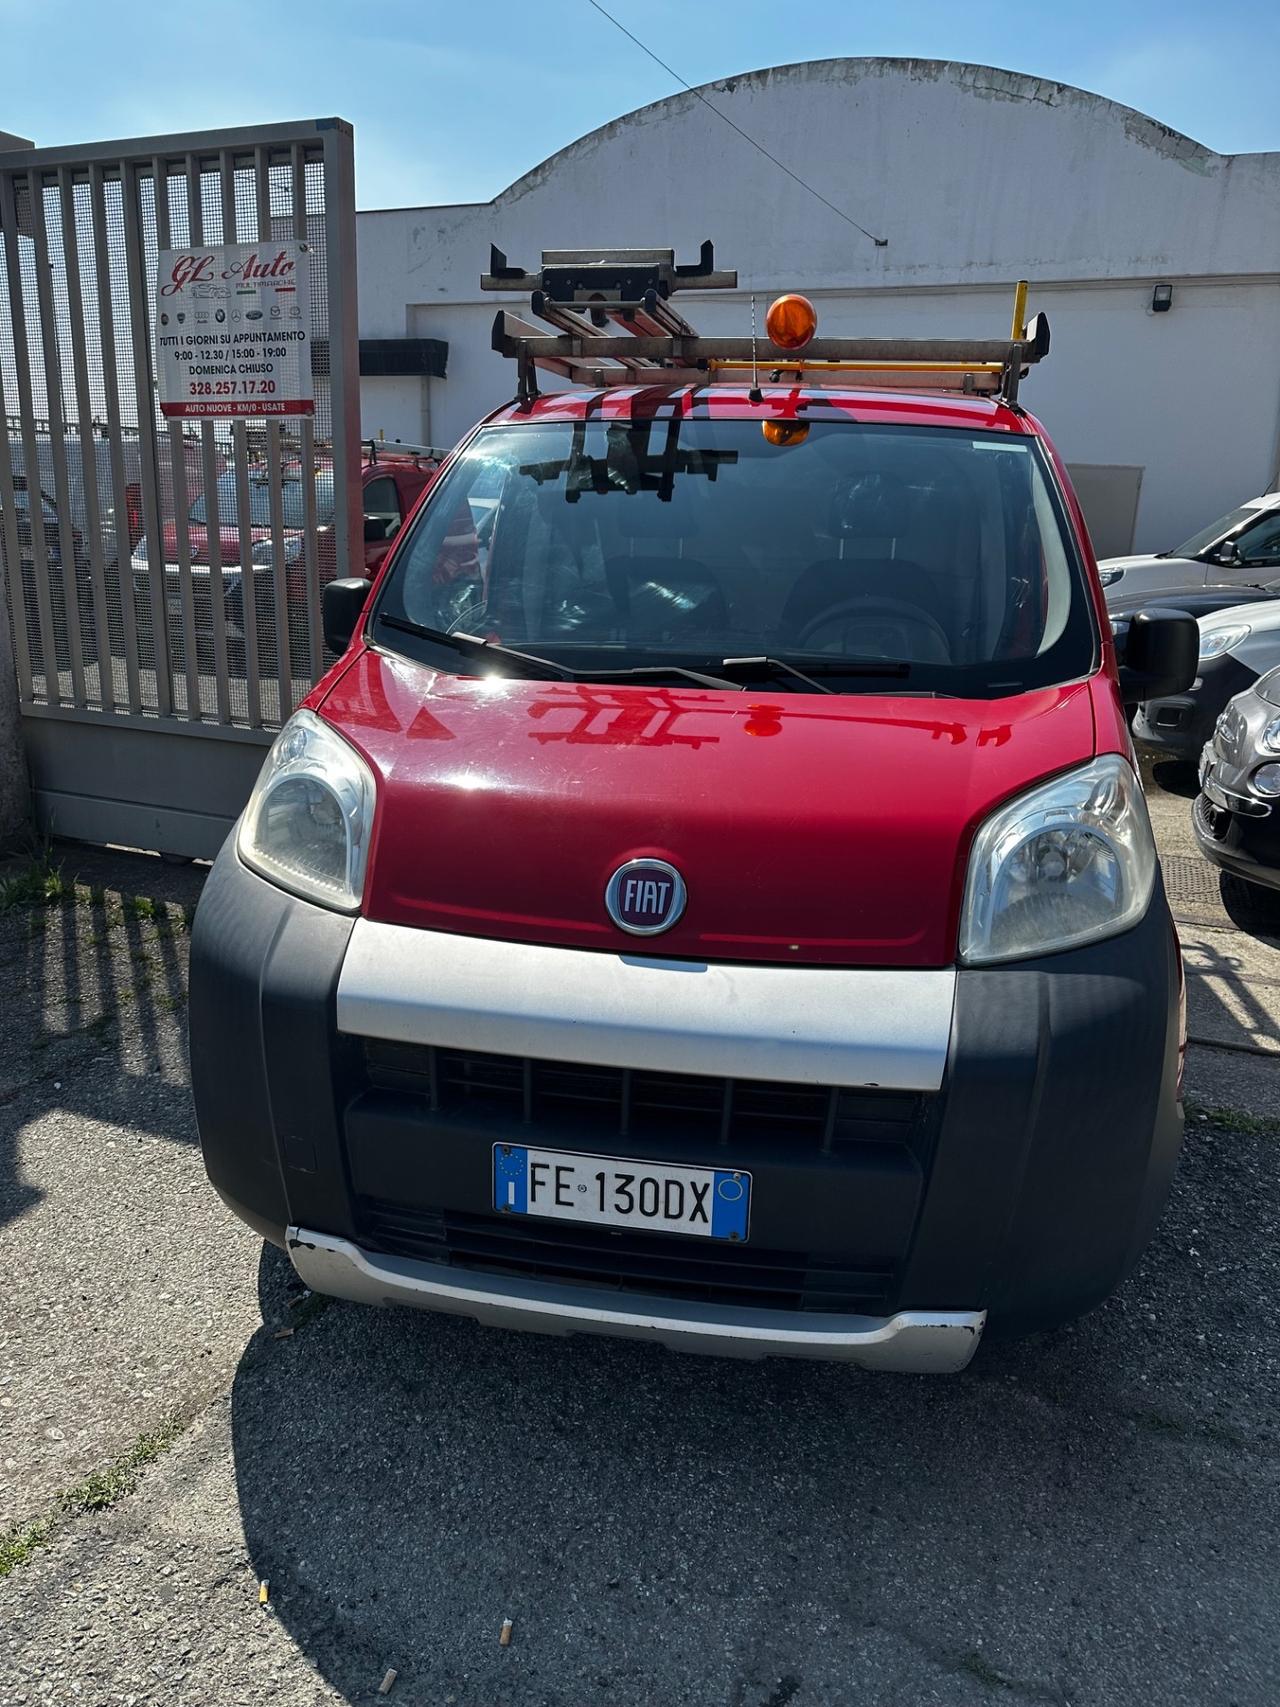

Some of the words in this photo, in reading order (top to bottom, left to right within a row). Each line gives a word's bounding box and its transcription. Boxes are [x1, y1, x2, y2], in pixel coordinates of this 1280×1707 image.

[161, 255, 215, 296] GL
[221, 250, 295, 280] Auto
[160, 337, 179, 346] TUTTI
[186, 335, 218, 345] GIORNI
[220, 334, 231, 344] SU
[233, 331, 306, 343] APPUNTAMENTO
[174, 351, 193, 360] 9:00
[200, 350, 224, 360] 12.30
[232, 349, 255, 359] 15:00
[263, 347, 287, 358] 19:00
[189, 364, 237, 375] DOMENICA
[238, 363, 274, 374] CHIUSO
[189, 380, 276, 395] 328.257.17.20
[185, 404, 205, 413] AUTO
[206, 403, 232, 412] NUOVE
[262, 402, 286, 412] USATE
[624, 879, 671, 915] FIAT
[530, 1162, 575, 1207] FE
[595, 1171, 711, 1224] 130DX
